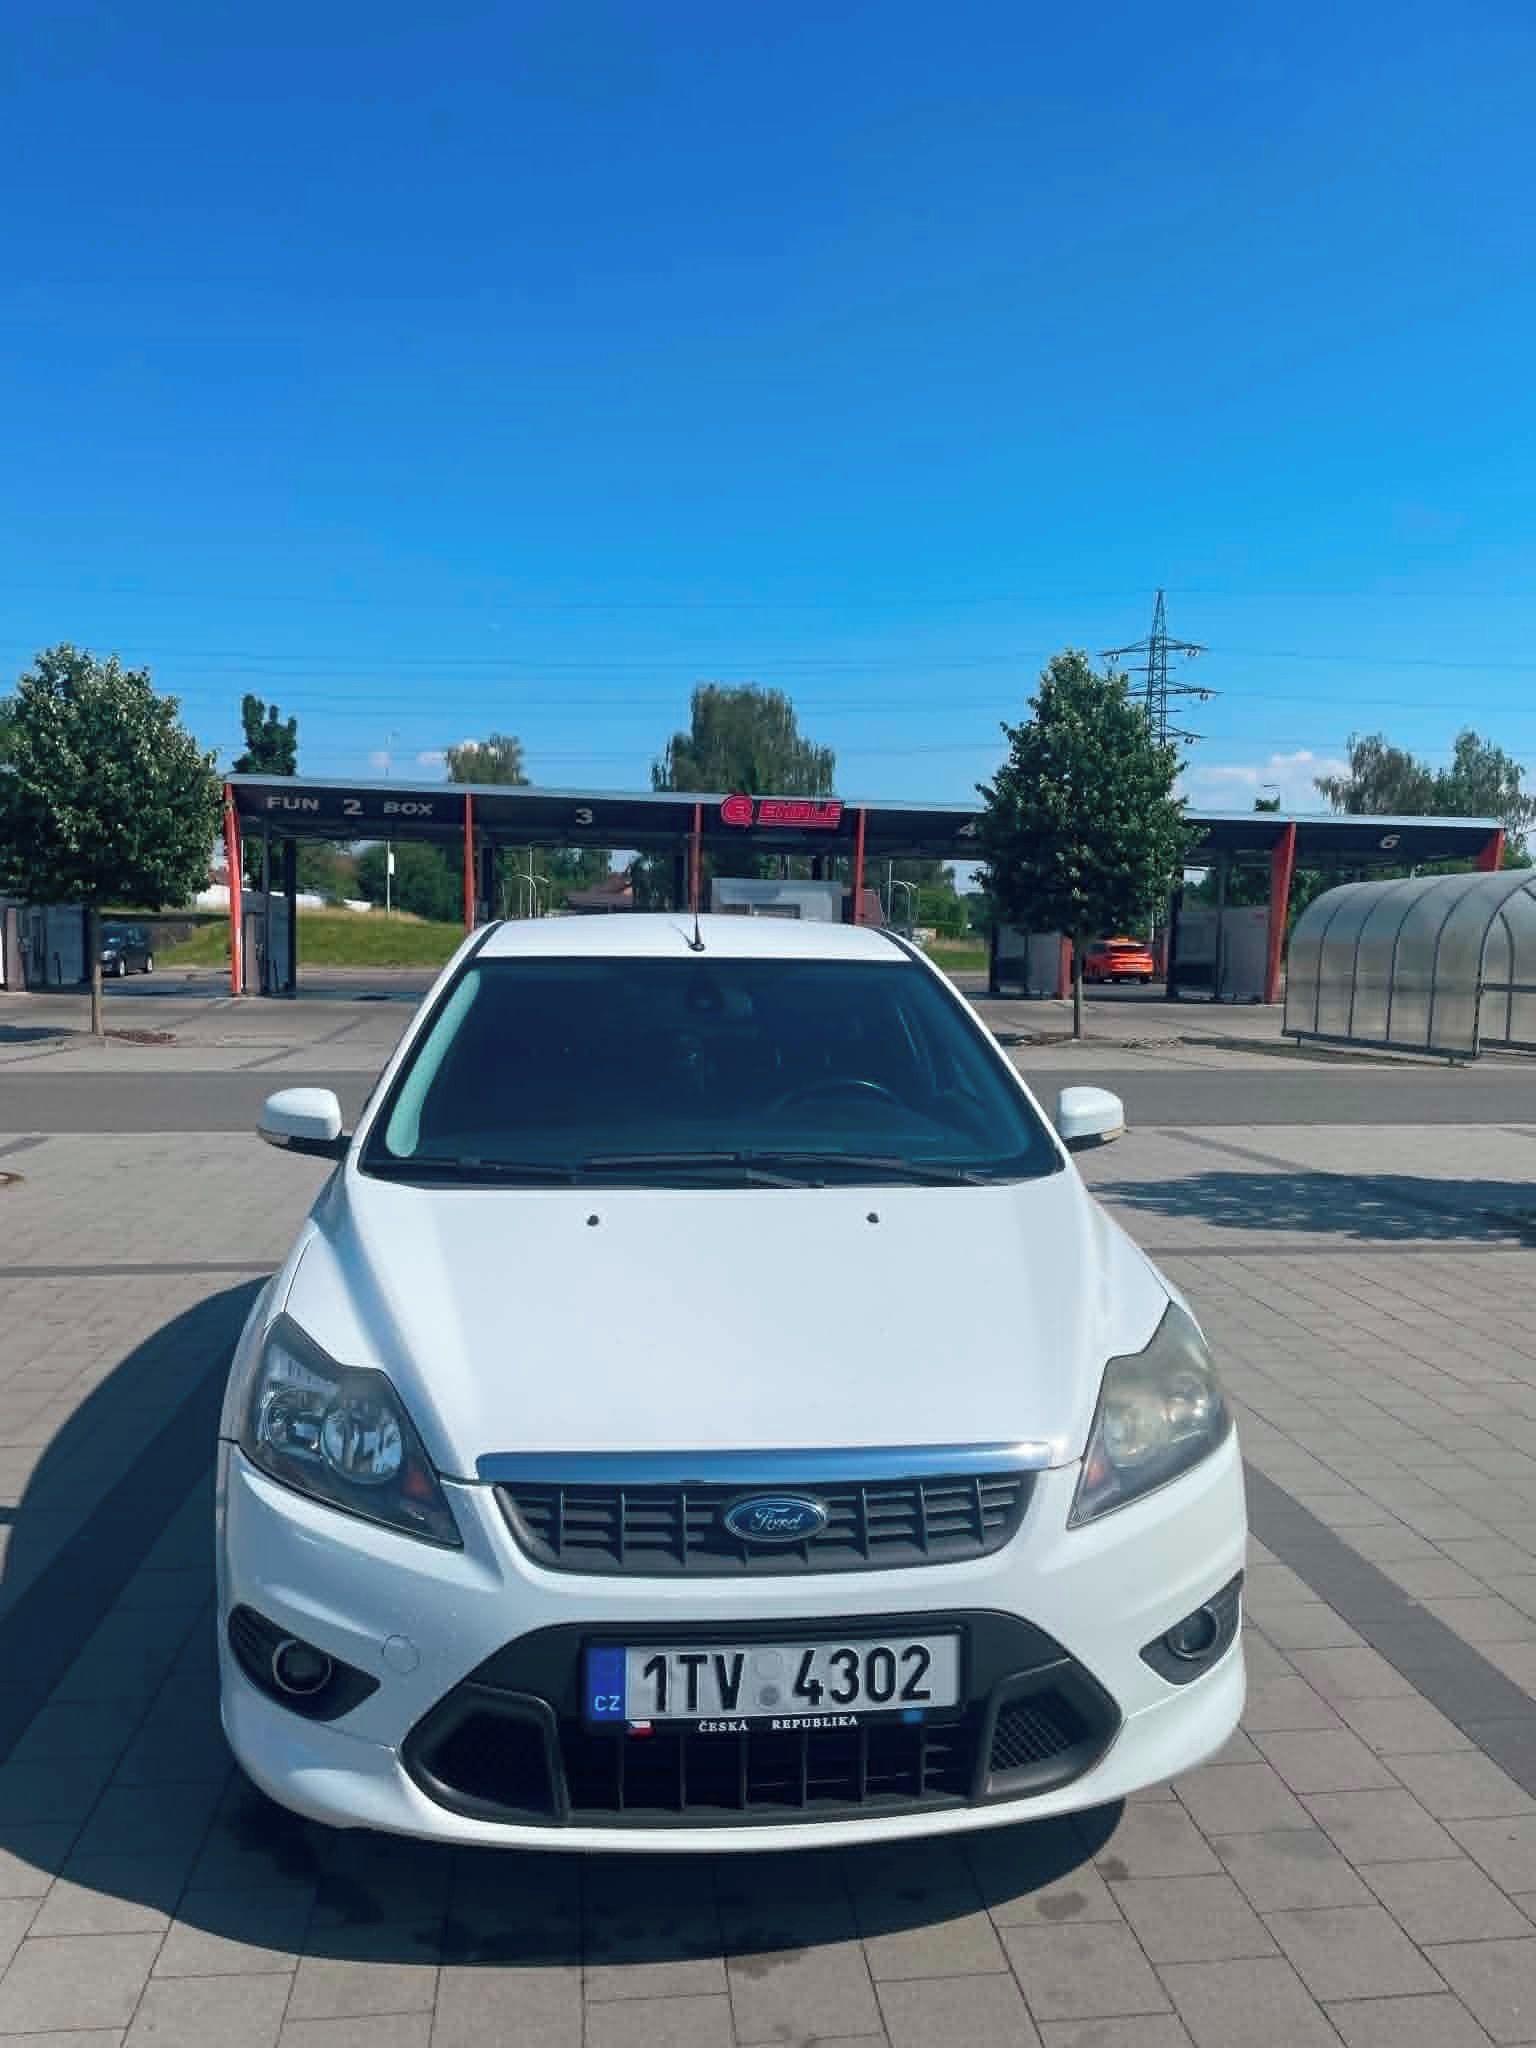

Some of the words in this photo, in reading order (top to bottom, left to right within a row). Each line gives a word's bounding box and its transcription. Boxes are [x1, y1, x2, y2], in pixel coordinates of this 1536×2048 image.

[266, 796, 319, 811] FUN
[343, 799, 364, 815] 2
[383, 801, 433, 815] BOX
[575, 807, 595, 825] 3
[1379, 834, 1401, 849] 6
[751, 1507, 804, 1528] Ford
[594, 1695, 621, 1712] CZ
[643, 1652, 745, 1713] 1TV
[793, 1644, 931, 1706] 4302
[698, 1719, 749, 1733] ČESKÁ
[771, 1714, 858, 1731] REPUBLIKA
